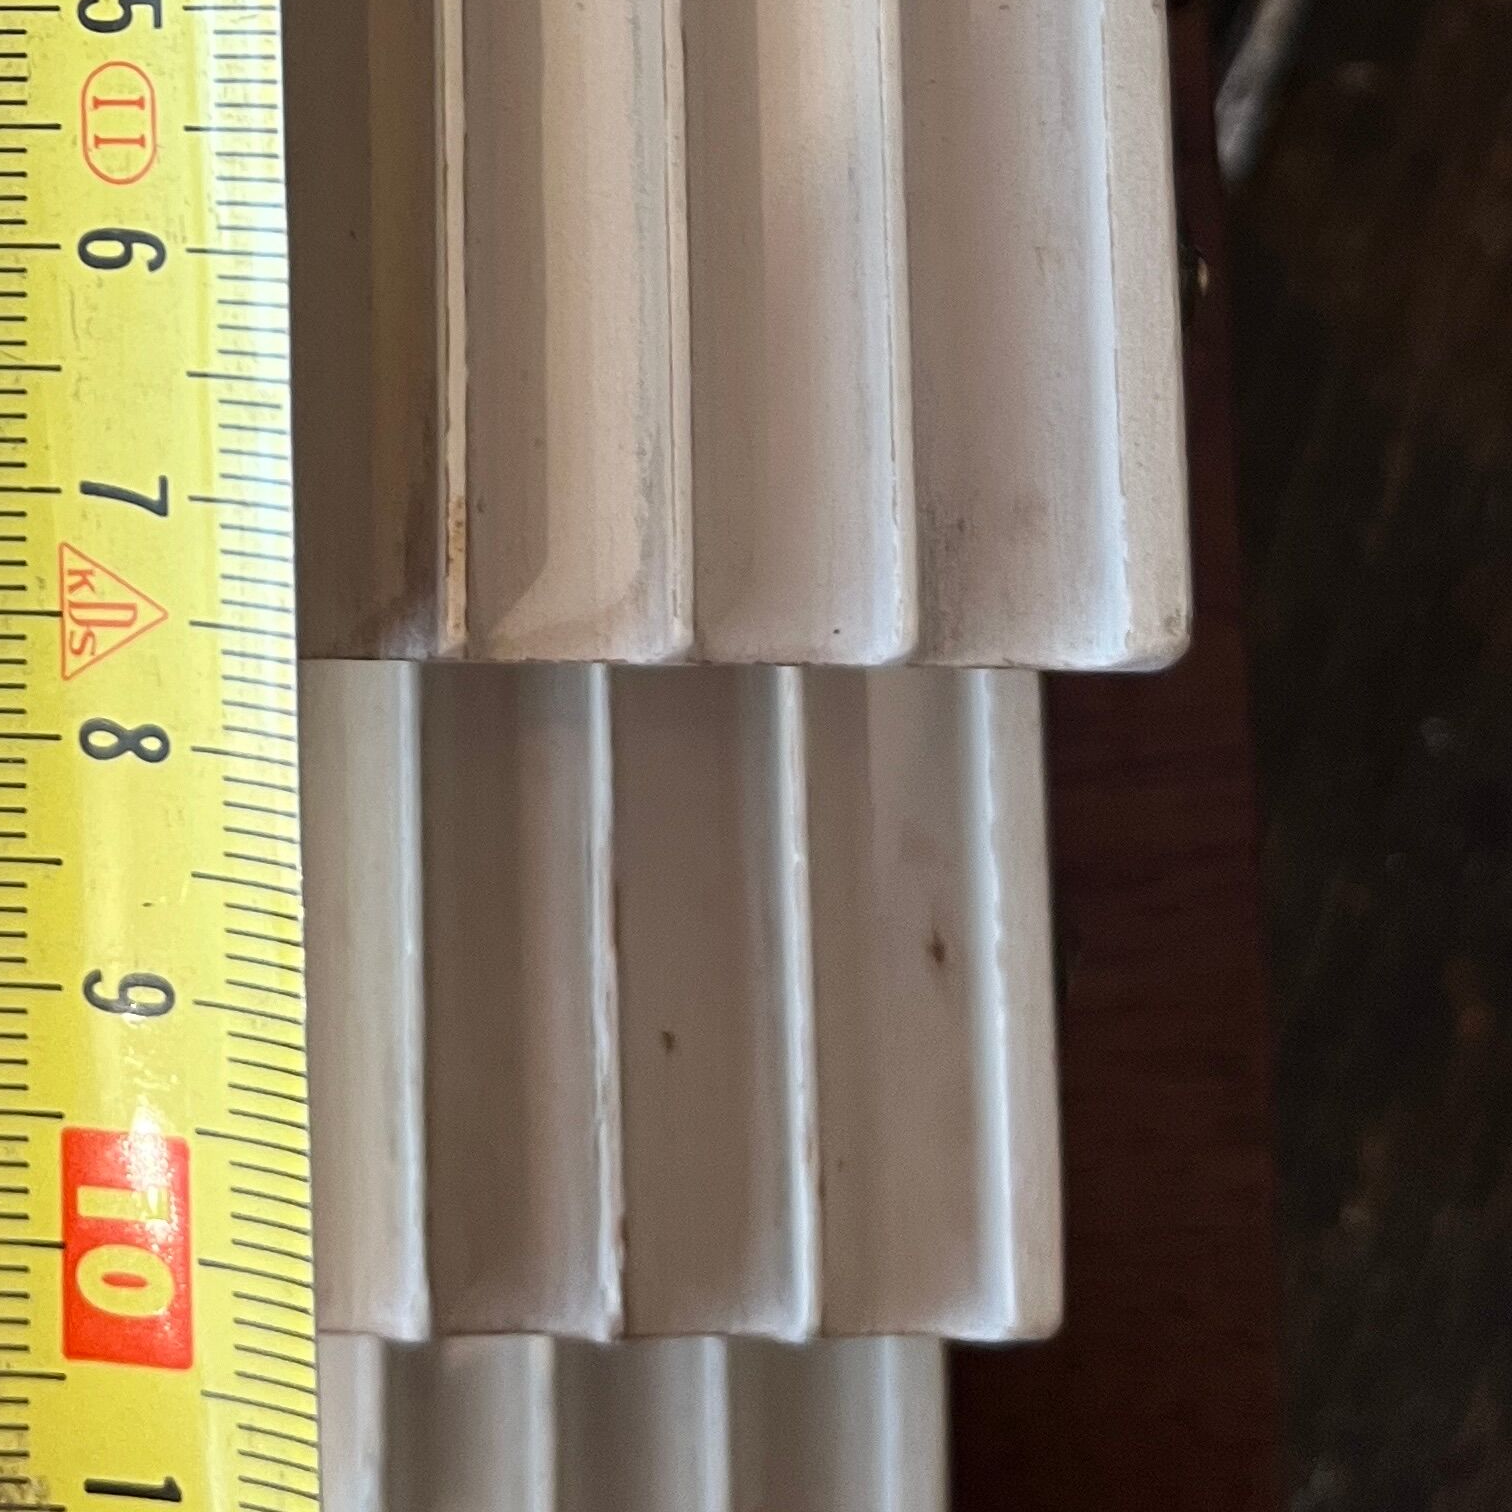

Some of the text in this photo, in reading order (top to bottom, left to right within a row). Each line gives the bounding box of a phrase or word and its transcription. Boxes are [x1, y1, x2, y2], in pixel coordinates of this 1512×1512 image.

[77, 226, 167, 273] 6
[78, 474, 169, 518] 7
[66, 568, 139, 657] KDS
[78, 716, 170, 764] 8
[82, 968, 176, 1018] 9
[75, 1184, 178, 1320] 10
